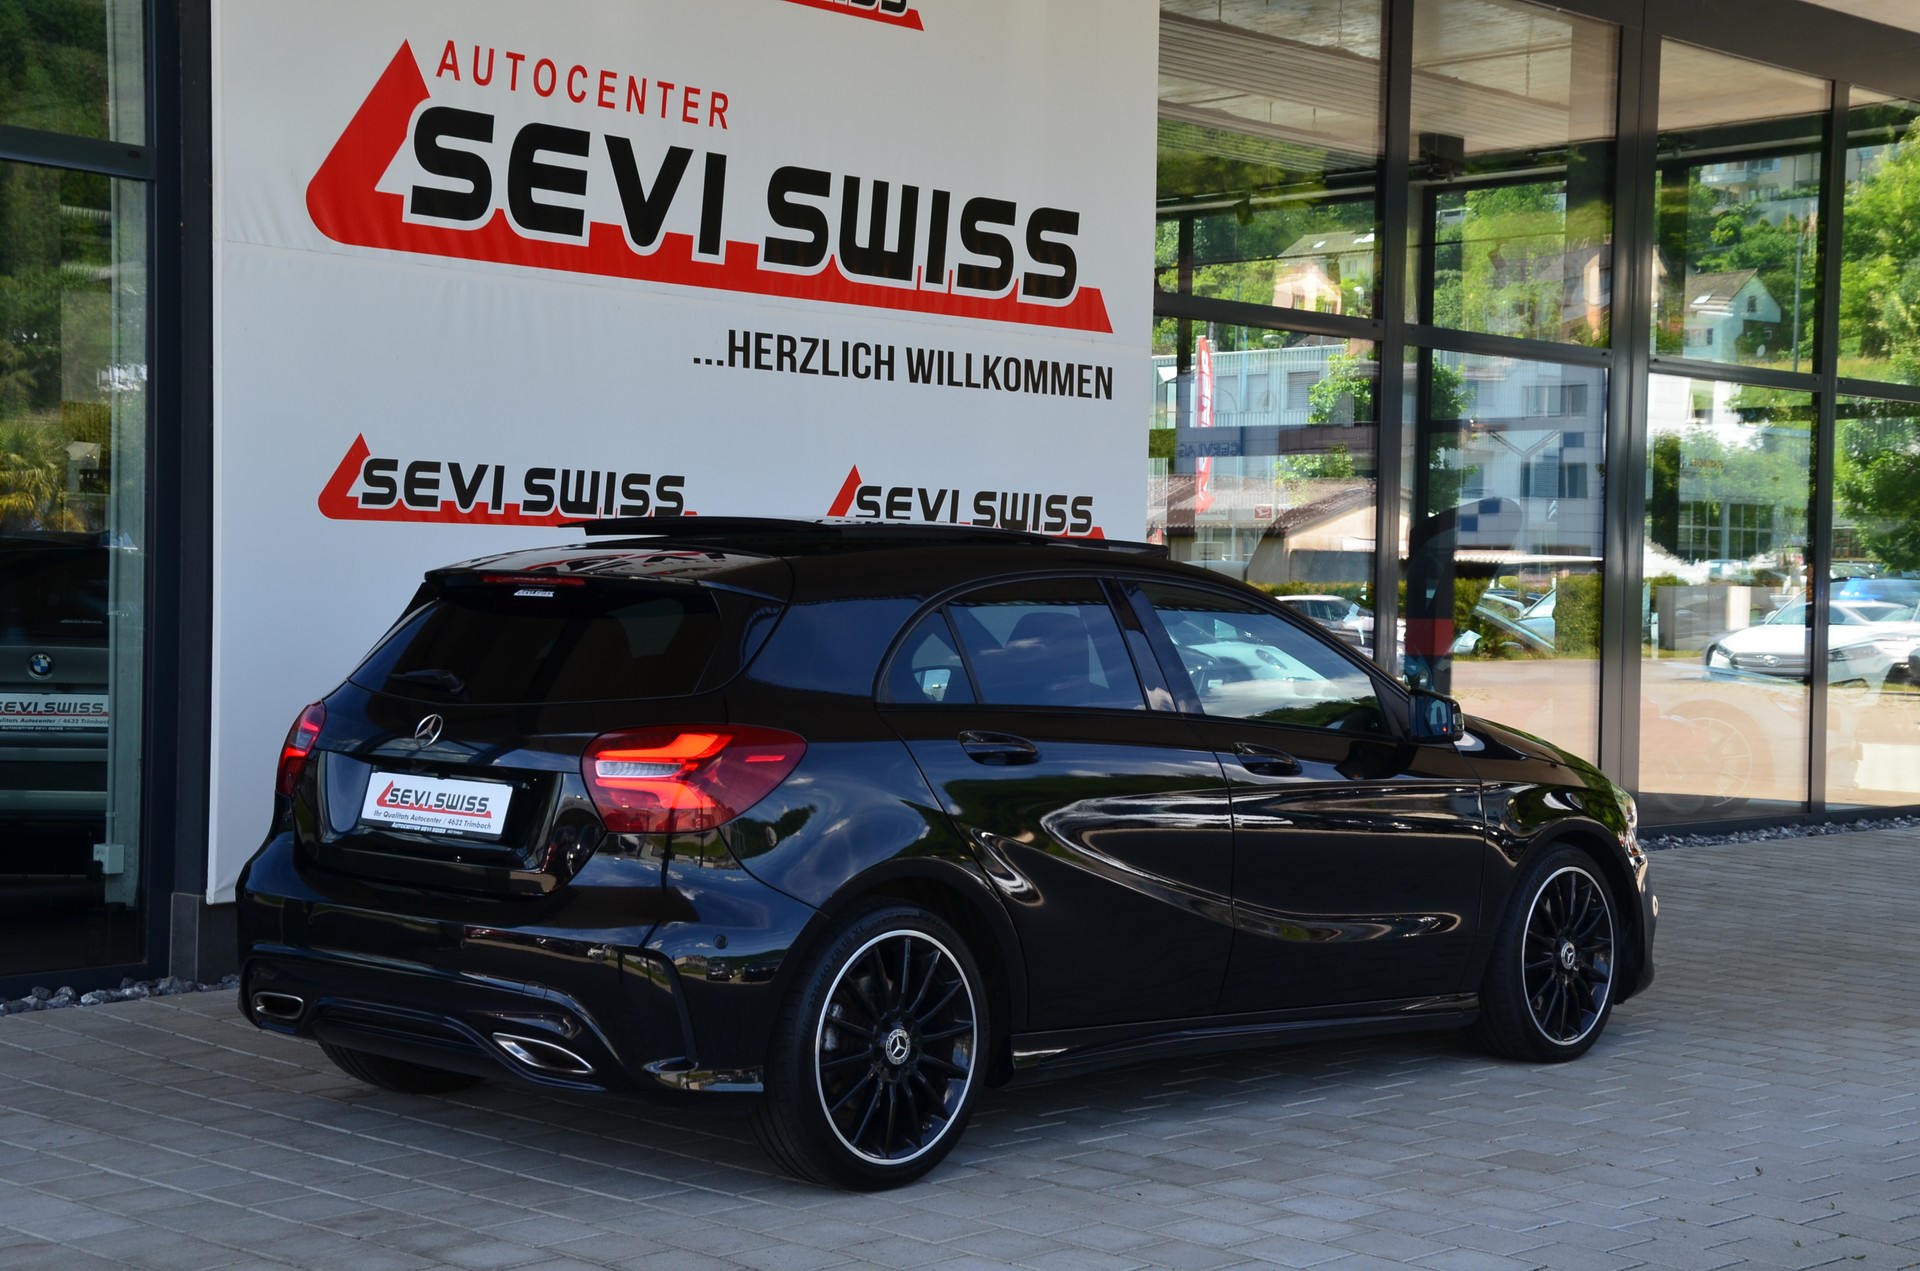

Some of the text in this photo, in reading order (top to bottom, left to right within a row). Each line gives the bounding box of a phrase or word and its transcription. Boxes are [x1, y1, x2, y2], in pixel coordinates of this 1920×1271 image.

[435, 39, 729, 130] AUTOCENTER
[410, 105, 1080, 300] SEVI SWISS
[905, 346, 1113, 401] WILLKOMMEN
[361, 457, 685, 517] SEVI SWISS
[856, 485, 1093, 533] SEVI SWISS
[0, 701, 104, 714] EVI SWISS
[388, 788, 490, 812] SEVI SWISS
[410, 814, 442, 825] Autocenter
[447, 818, 463, 828] 4632
[463, 819, 491, 830] Trimbach
